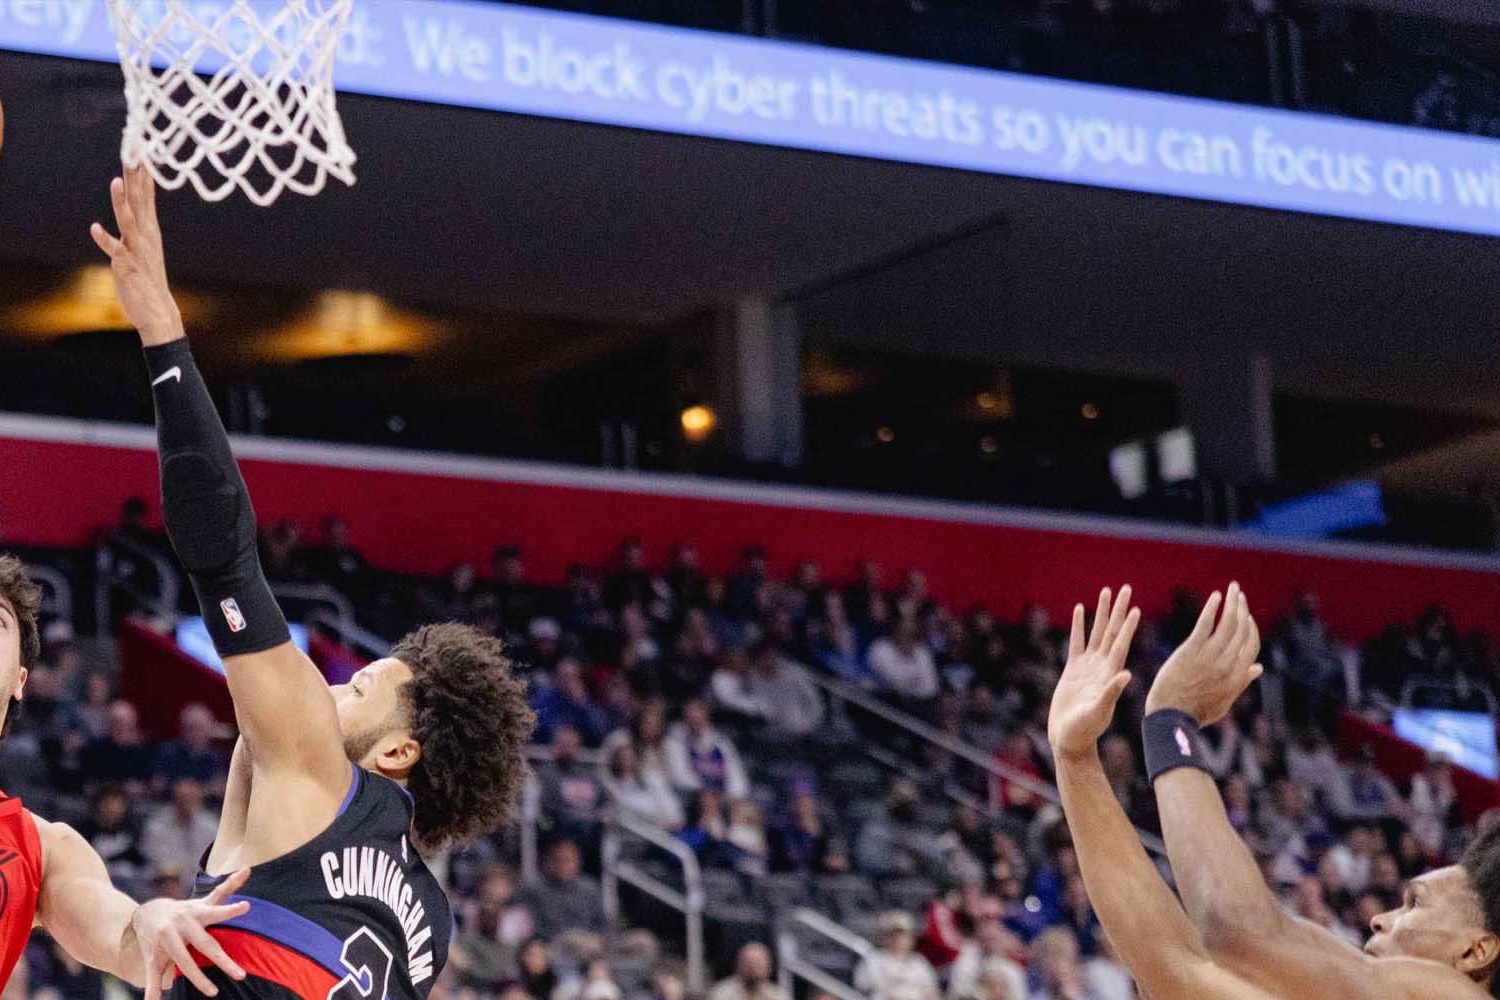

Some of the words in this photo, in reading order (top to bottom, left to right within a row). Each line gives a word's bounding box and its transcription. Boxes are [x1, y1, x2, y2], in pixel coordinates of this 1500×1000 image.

[402, 17, 492, 82] We
[503, 27, 644, 97] block
[656, 54, 798, 121] cyber
[809, 69, 980, 147] threats
[991, 103, 1048, 152] so
[1056, 112, 1147, 168] you
[1158, 127, 1244, 178] can
[1252, 124, 1374, 195] focus
[1382, 158, 1440, 202] on
[320, 846, 434, 986] CUNNINGHAM
